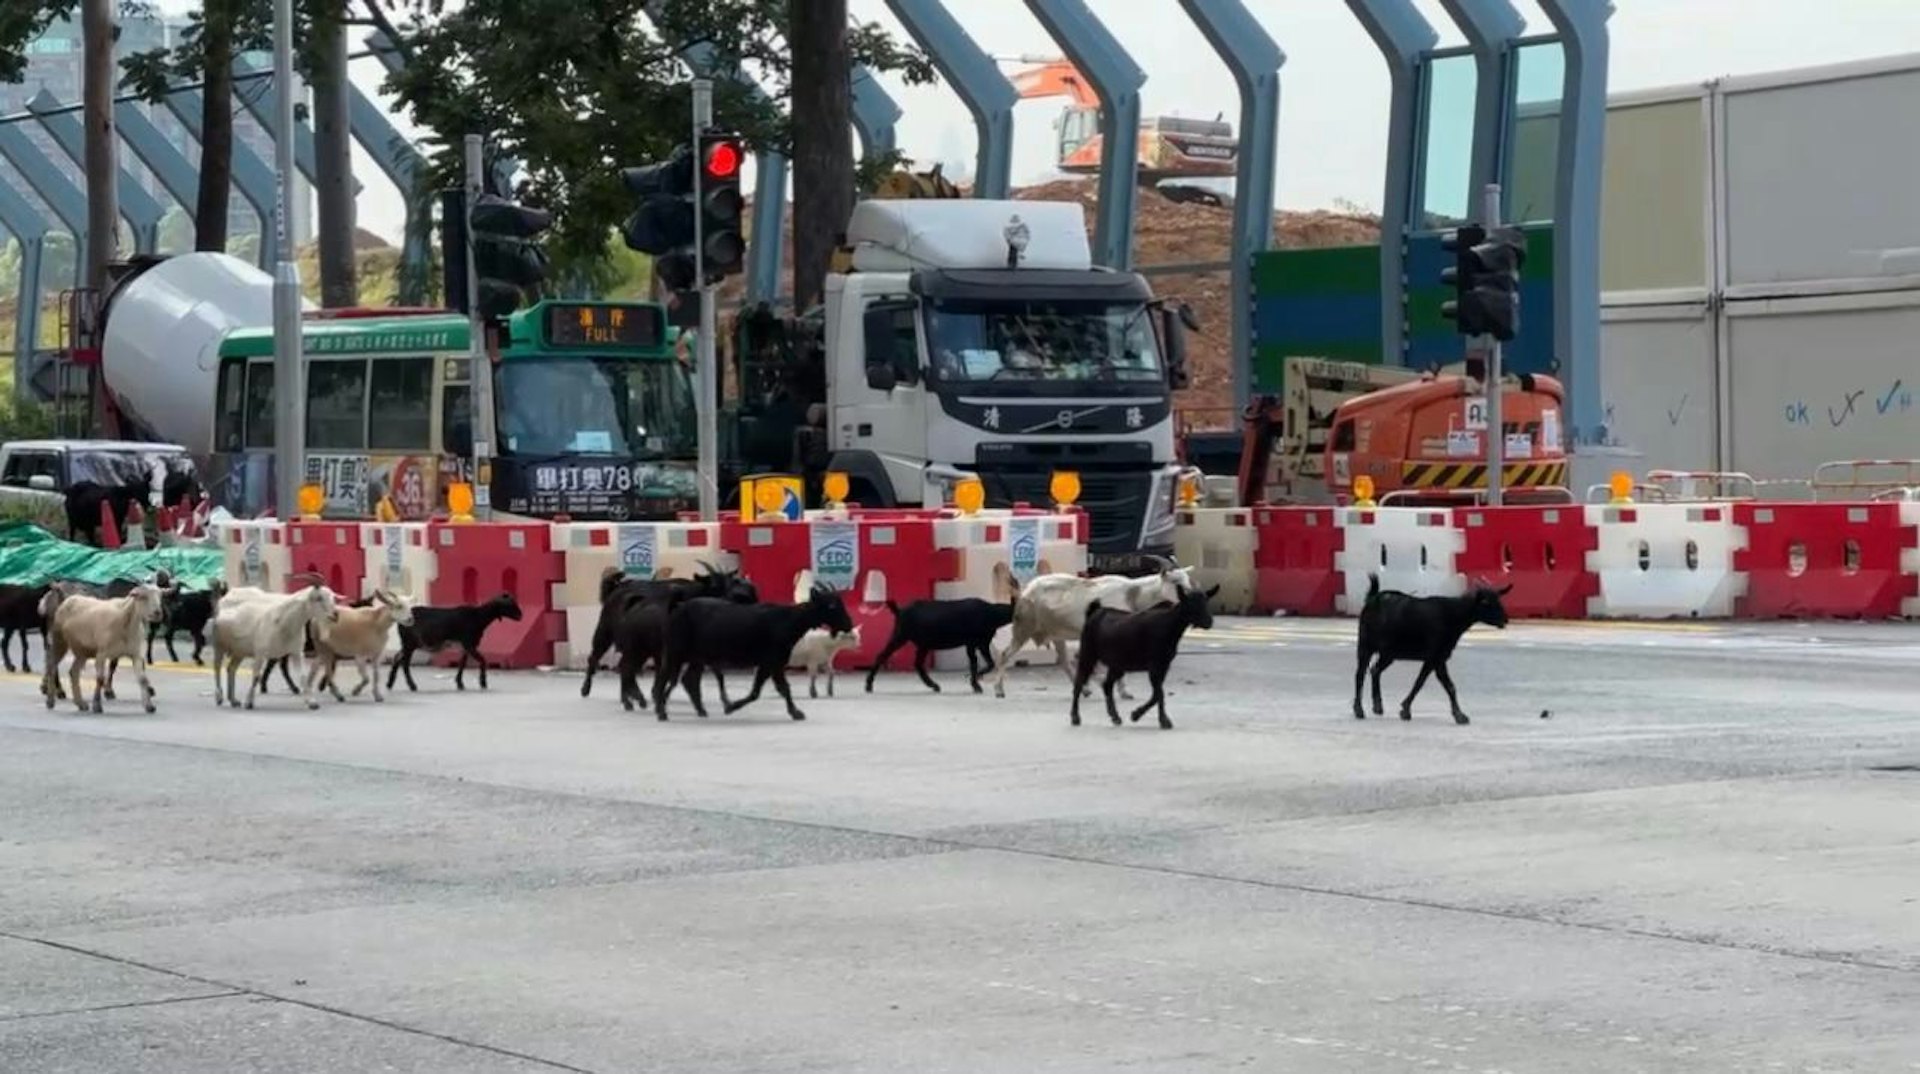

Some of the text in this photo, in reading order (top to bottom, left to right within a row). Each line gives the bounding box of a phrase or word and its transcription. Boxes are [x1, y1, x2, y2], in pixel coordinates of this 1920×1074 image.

[585, 327, 619, 342] FULL
[1786, 402, 1809, 424] OK
[817, 551, 853, 565] CEDD
